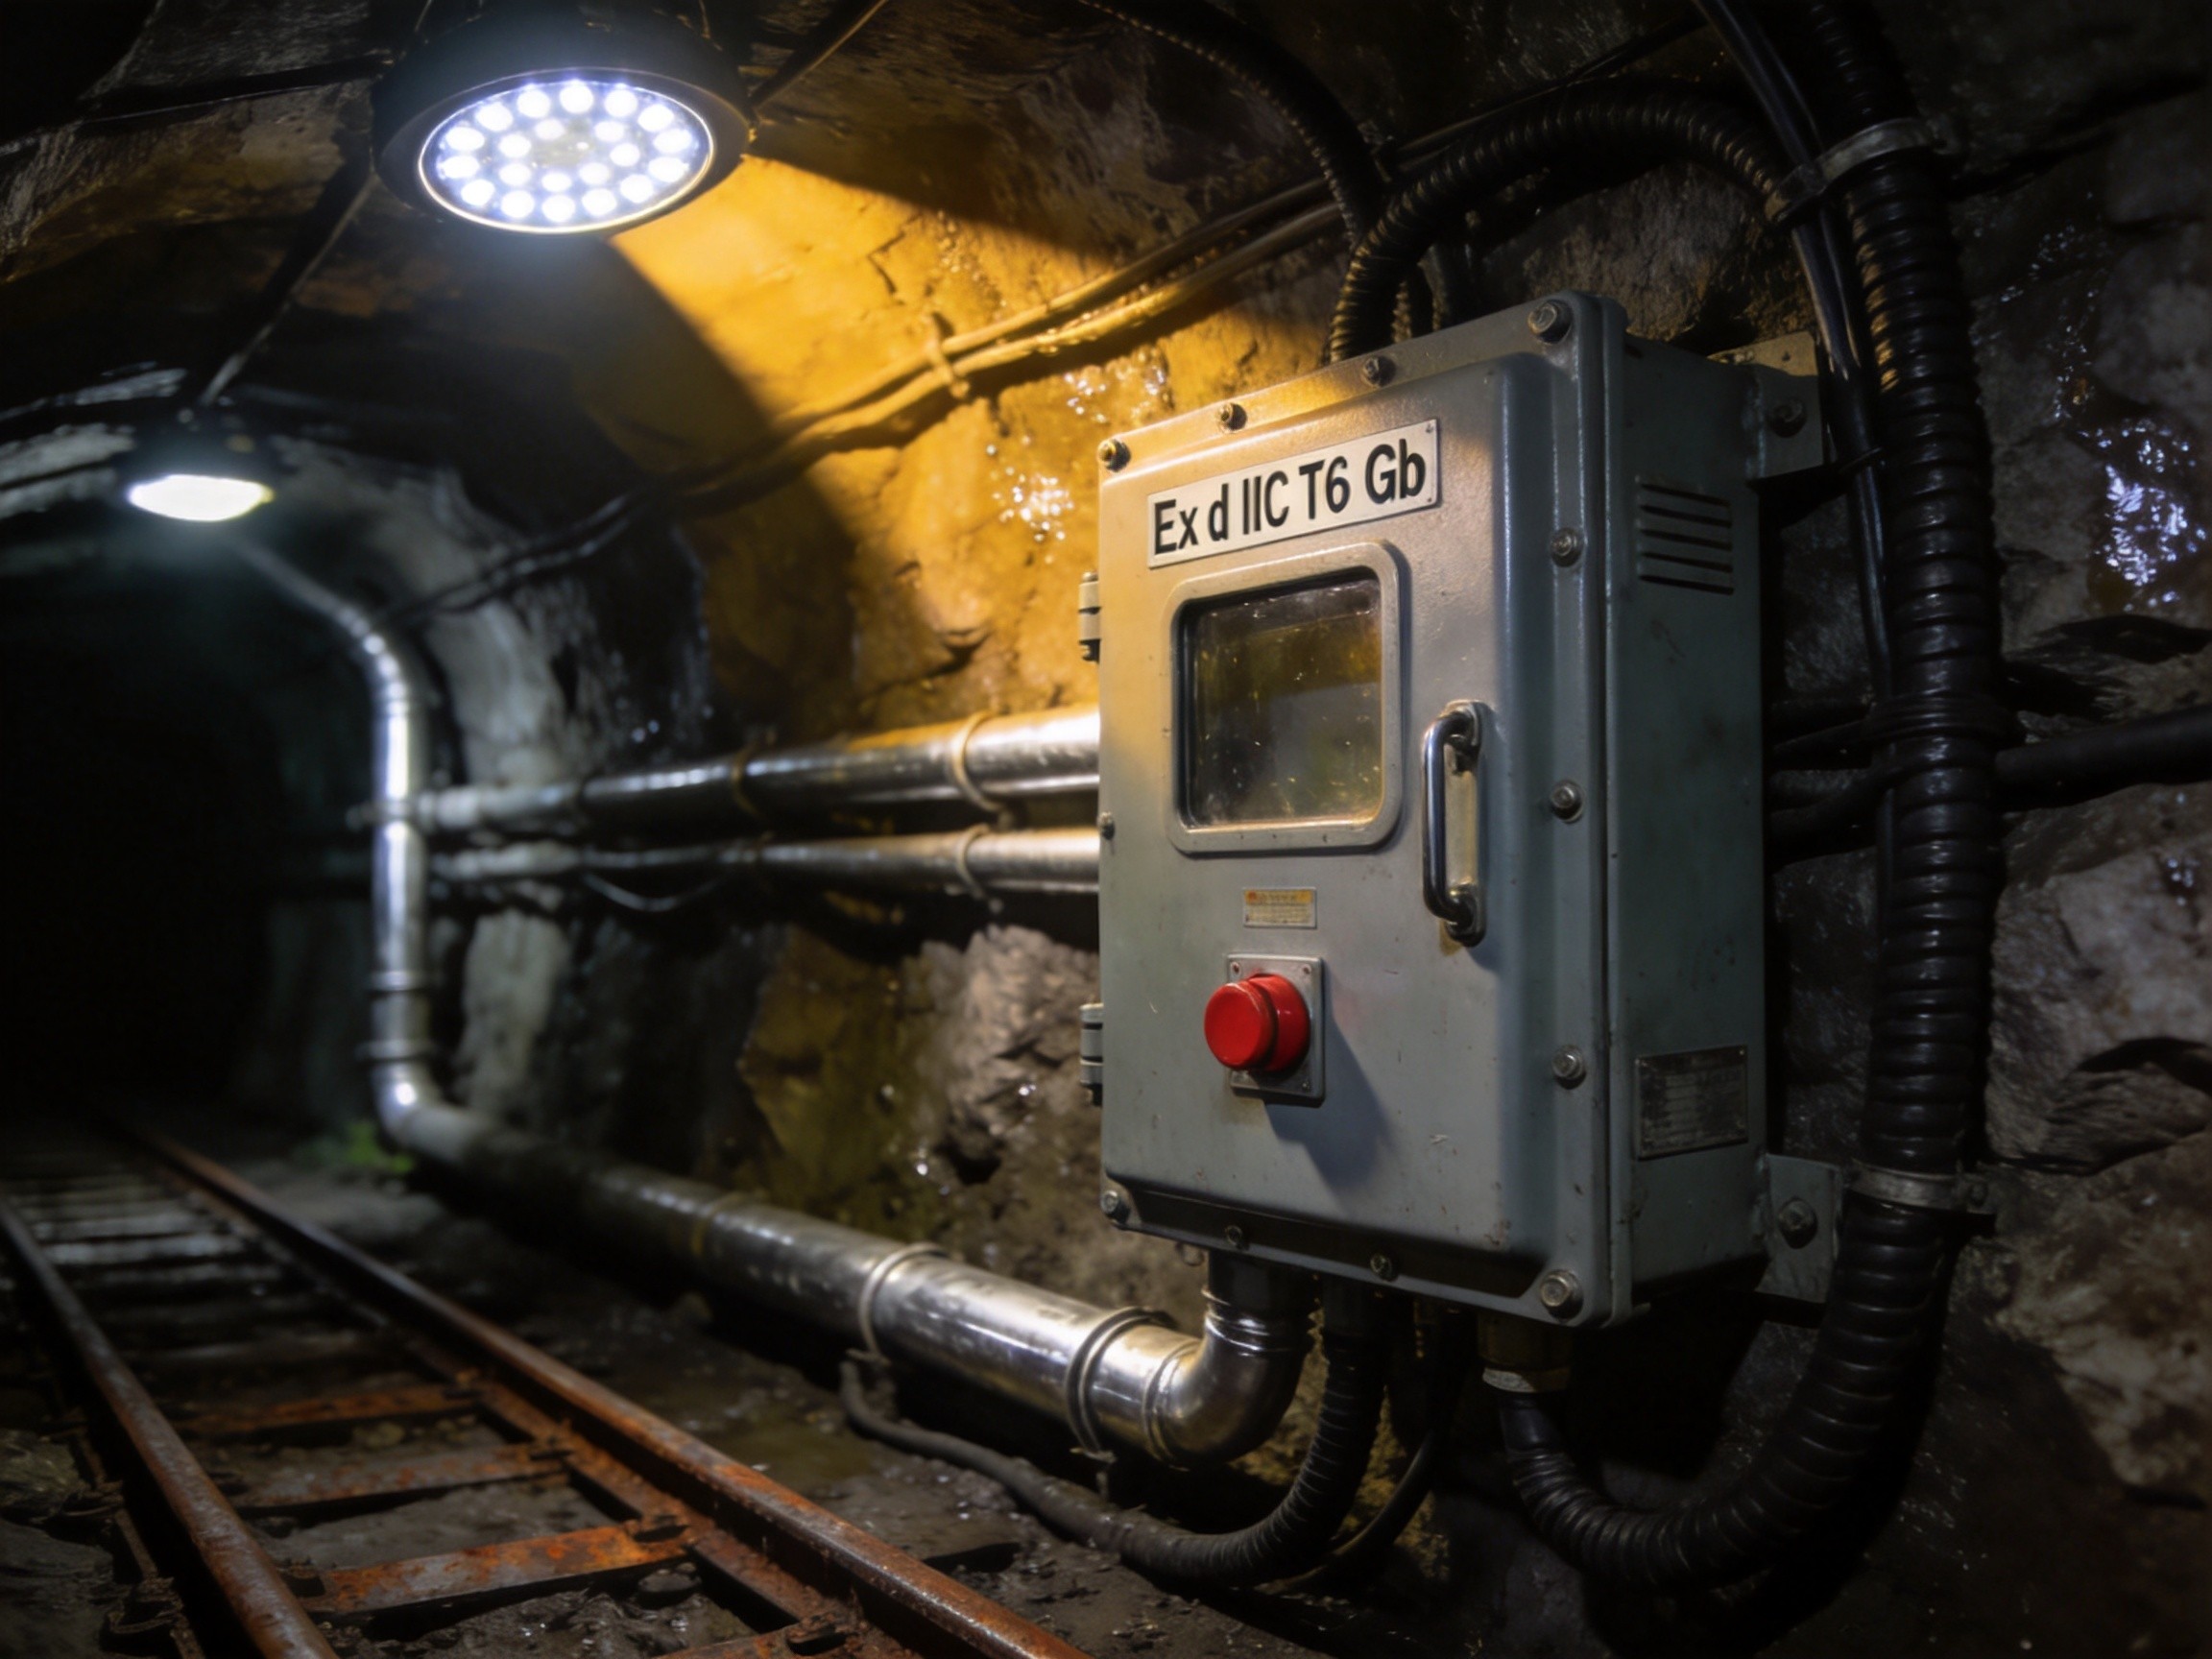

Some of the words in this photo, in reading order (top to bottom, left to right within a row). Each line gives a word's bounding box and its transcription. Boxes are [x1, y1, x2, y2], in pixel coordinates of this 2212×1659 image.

[1154, 499, 1199, 555] Ex
[1208, 483, 1229, 541] d
[1242, 470, 1289, 535] IIC
[1299, 456, 1350, 519] T6
[1364, 439, 1426, 504] Gb
